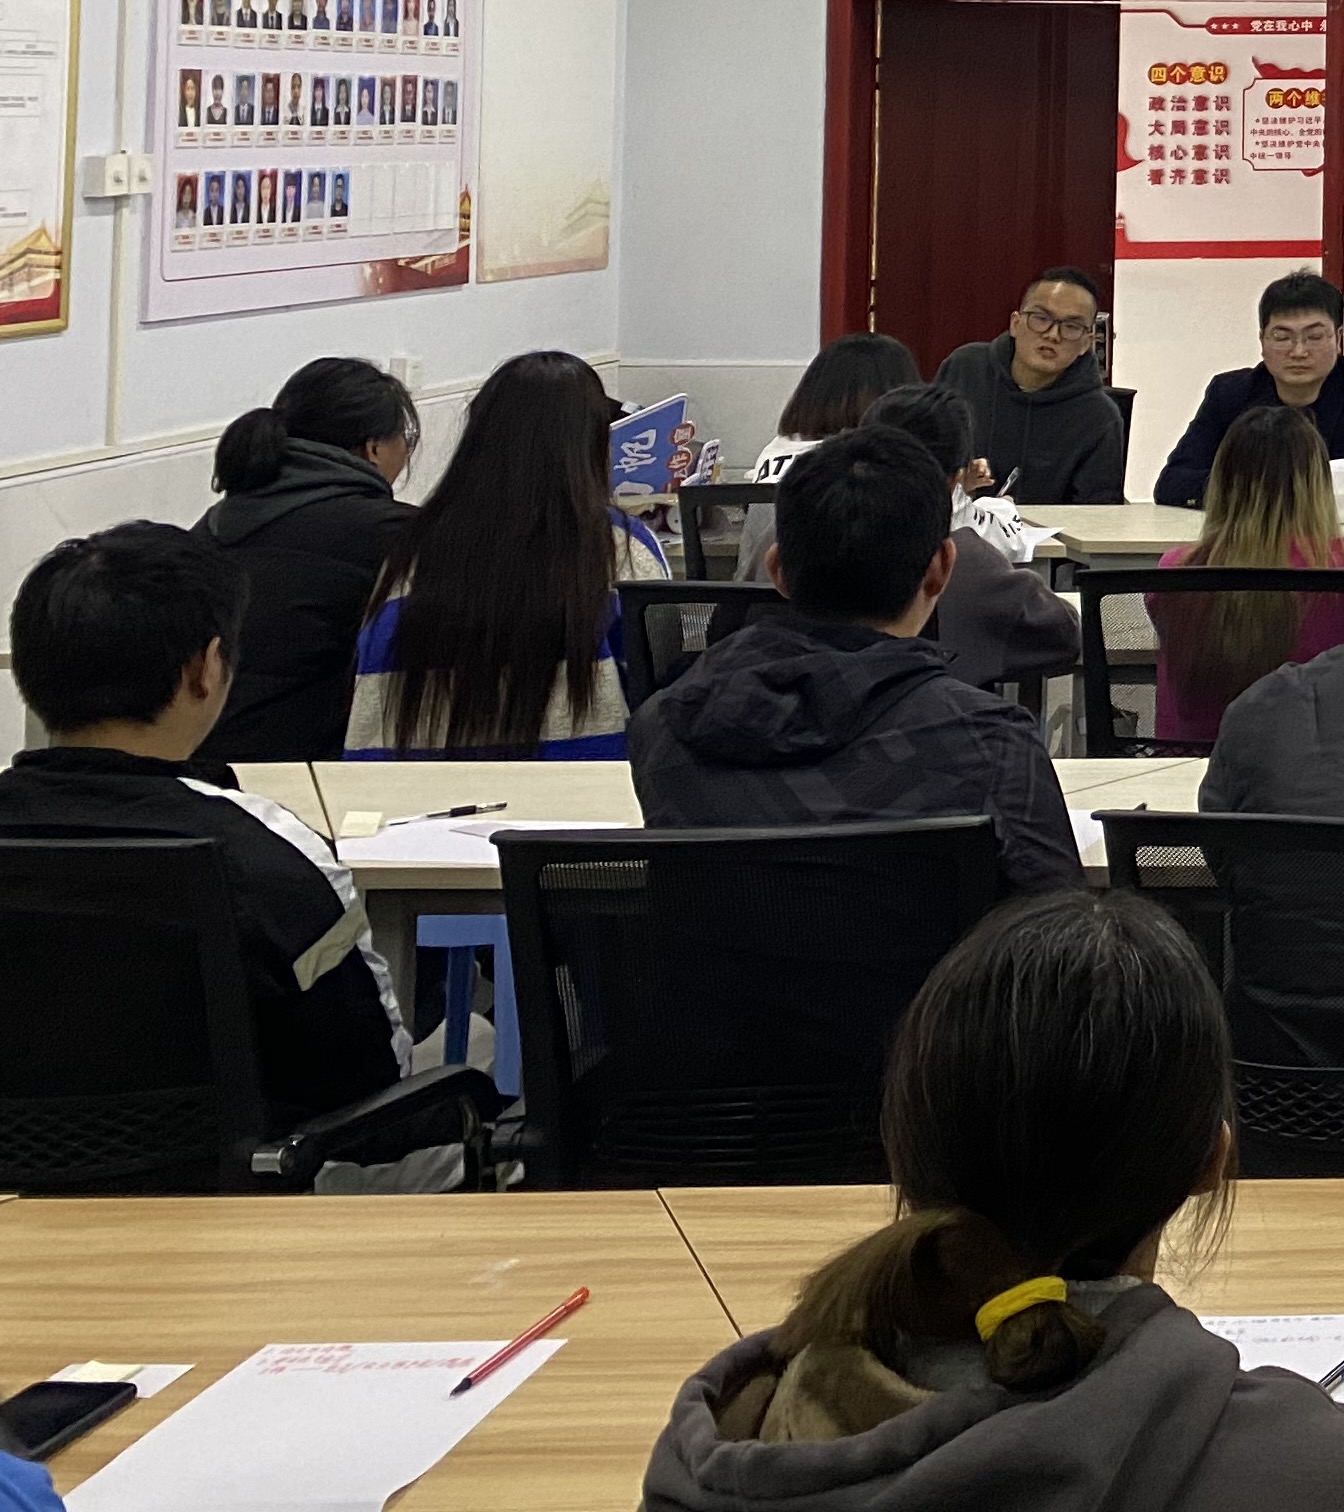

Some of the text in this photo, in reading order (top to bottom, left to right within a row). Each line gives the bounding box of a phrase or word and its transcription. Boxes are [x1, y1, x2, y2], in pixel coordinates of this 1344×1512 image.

[1150, 65, 1226, 84] 四个意识
[1148, 95, 1231, 112] 政治意识
[1269, 90, 1325, 107] 两个维
[1148, 119, 1231, 136] 大局意识
[1262, 116, 1324, 125] 坚决维护习近平
[1250, 128, 1324, 137] 中央的核心、全党的
[1148, 144, 1231, 161] 核心意识
[1261, 140, 1324, 148] 坚决维护党中央
[1148, 168, 1231, 185] 看齐意识
